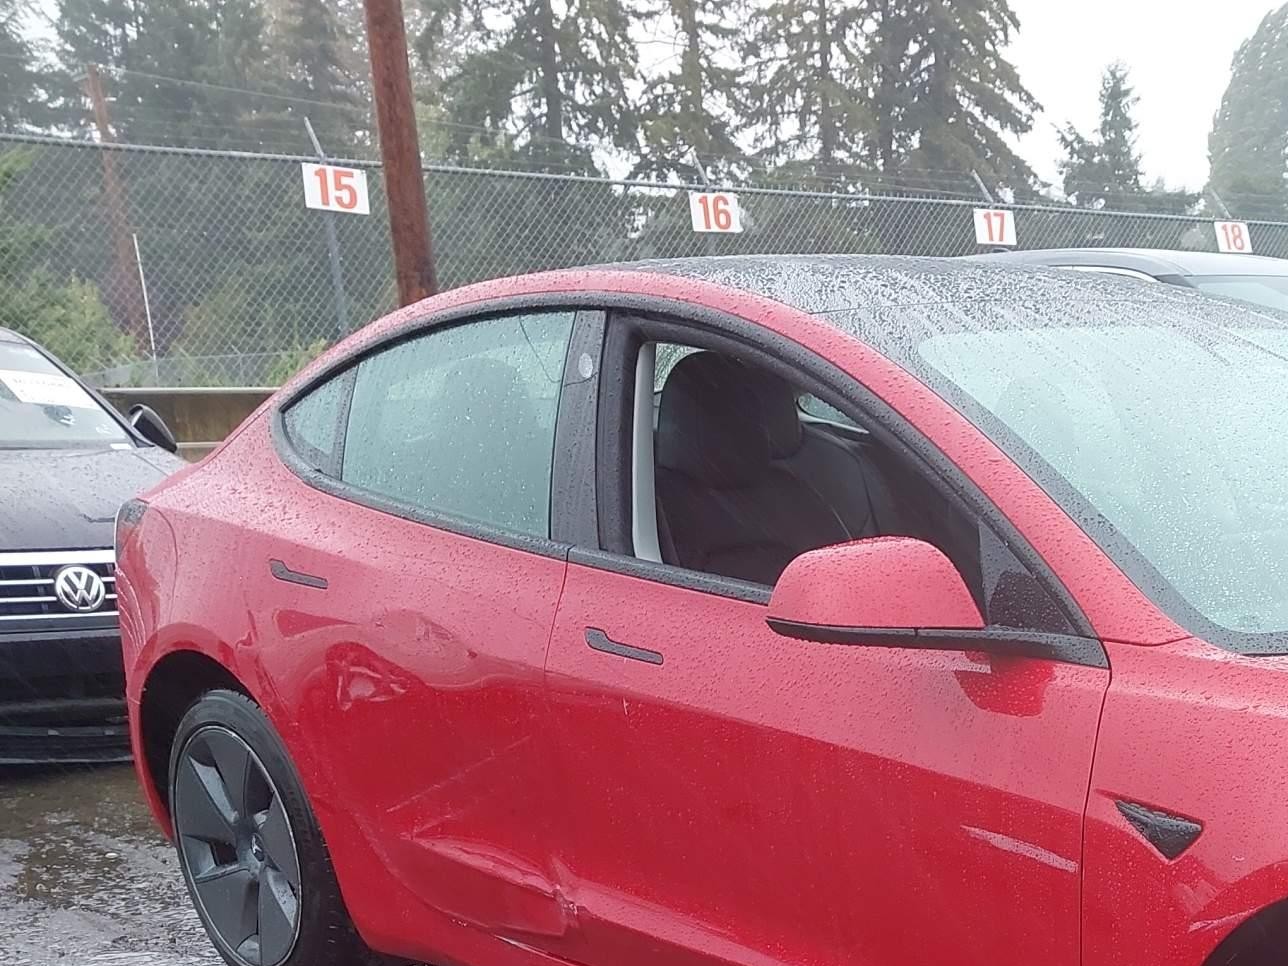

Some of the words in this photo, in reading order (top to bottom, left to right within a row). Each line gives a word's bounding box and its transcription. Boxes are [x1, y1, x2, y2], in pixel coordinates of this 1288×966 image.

[314, 167, 358, 209] 15
[698, 195, 732, 230] 16
[983, 211, 1005, 242] 17
[1221, 223, 1245, 251] 18
[58, 567, 103, 609] VW
